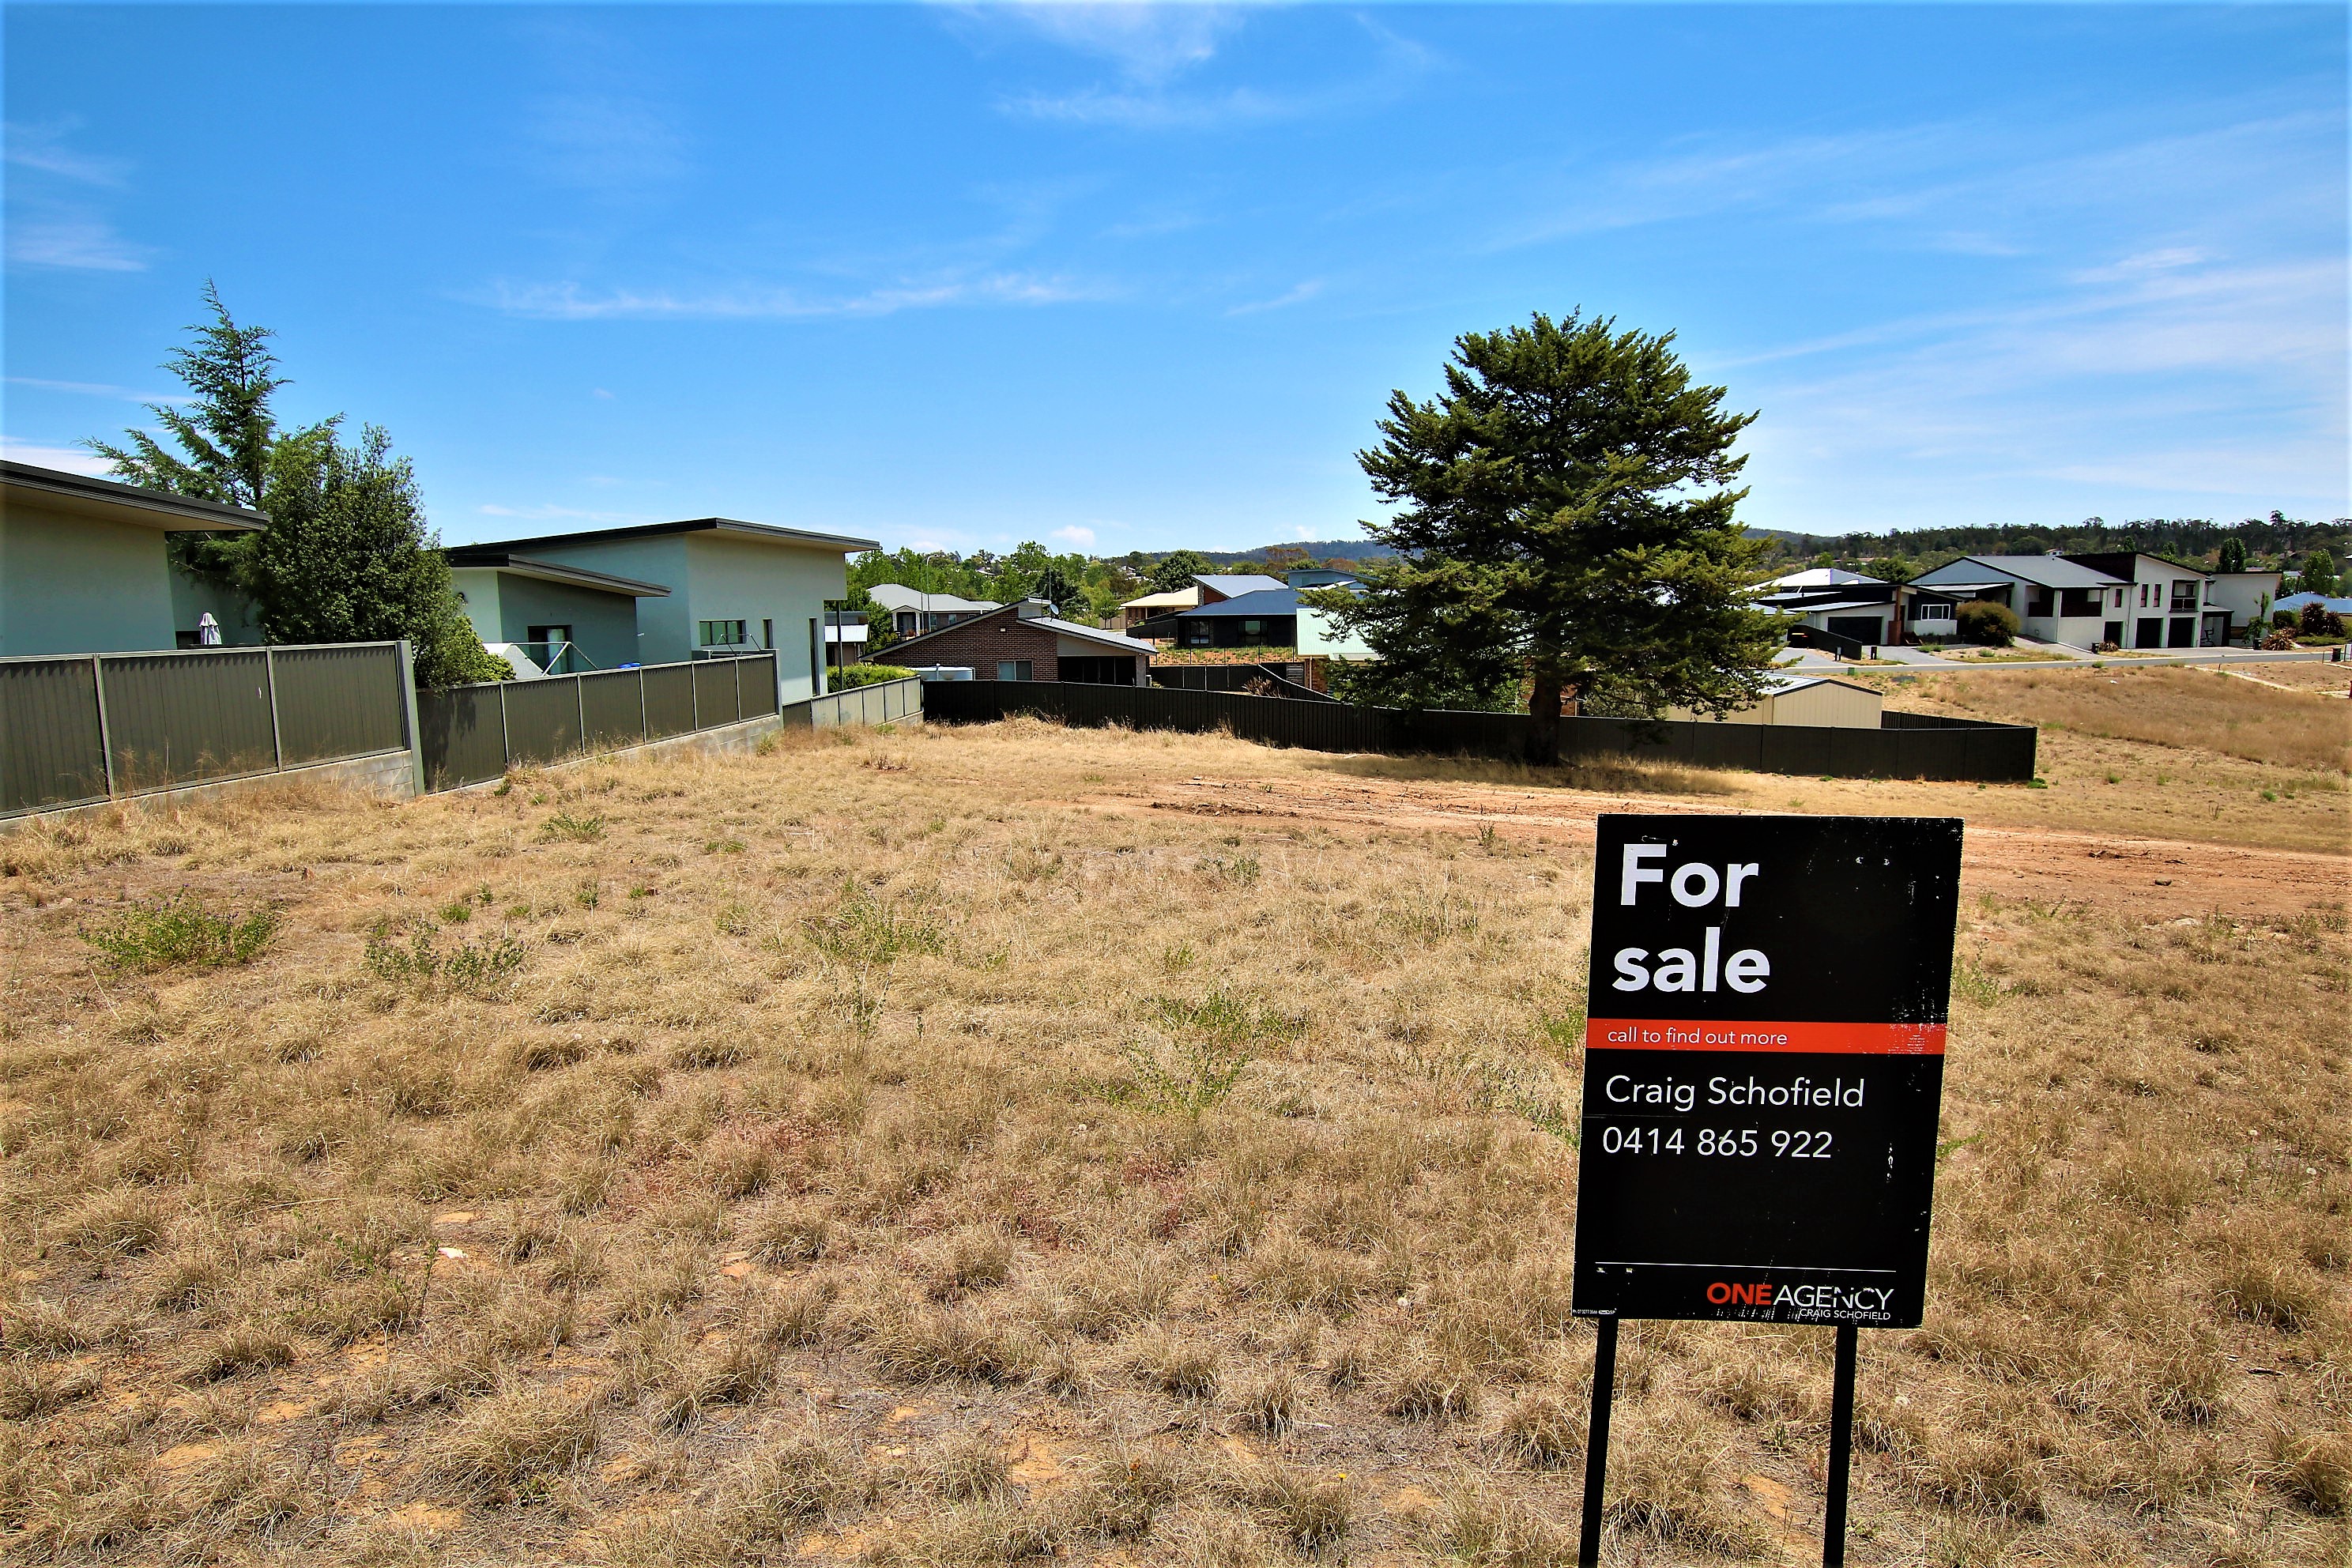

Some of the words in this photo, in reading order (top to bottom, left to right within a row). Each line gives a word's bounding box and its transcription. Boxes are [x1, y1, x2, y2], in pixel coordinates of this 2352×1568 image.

[1621, 844, 1758, 907] For
[1612, 927, 1770, 993] sale
[1608, 1027, 1637, 1042] call
[1642, 1029, 1661, 1043] to
[1666, 1027, 1700, 1044] find
[1705, 1031, 1736, 1044] out
[1740, 1034, 1788, 1046] more
[1606, 1075, 1695, 1112] Craig
[1708, 1076, 1864, 1107] Schofield
[1603, 1126, 1685, 1155] 0414
[1697, 1129, 1758, 1156] 865
[1771, 1130, 1833, 1159] 922
[1800, 1308, 1831, 1318] CRAIG
[1834, 1310, 1891, 1321] SCHOFIELD
